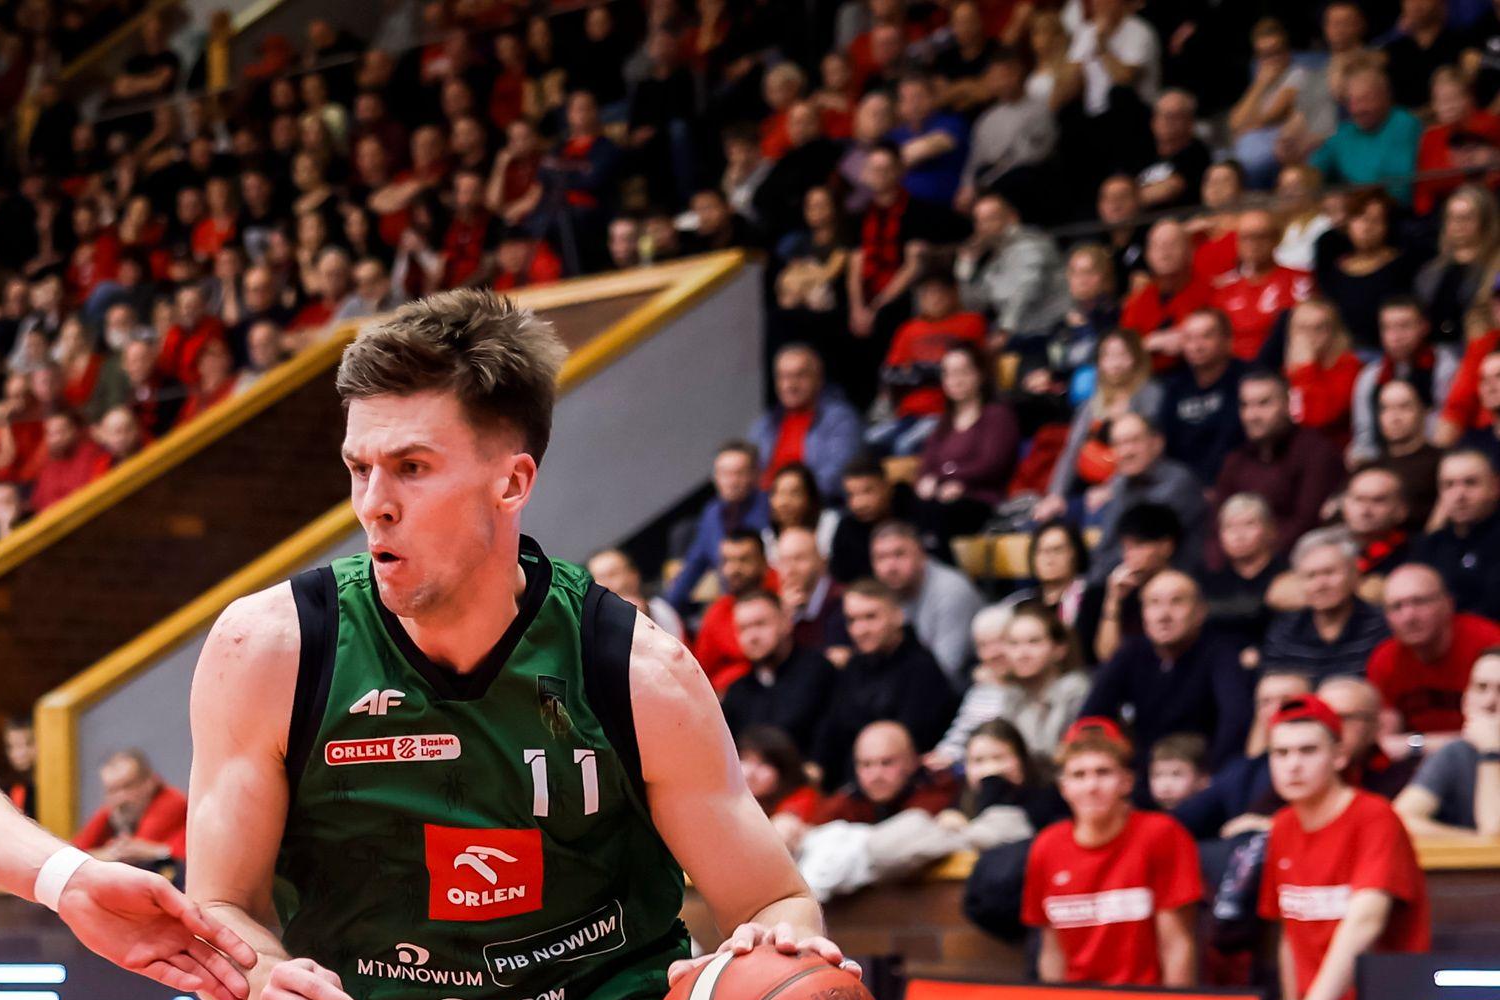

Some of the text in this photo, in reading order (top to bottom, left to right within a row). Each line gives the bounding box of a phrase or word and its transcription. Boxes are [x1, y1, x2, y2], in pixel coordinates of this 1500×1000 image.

[331, 743, 389, 760] ORLEN
[420, 737, 454, 747] Basket
[420, 748, 442, 758] Liga
[523, 748, 600, 817] 11
[447, 885, 526, 907] ORLEN
[494, 914, 617, 974] PIB NOWUM
